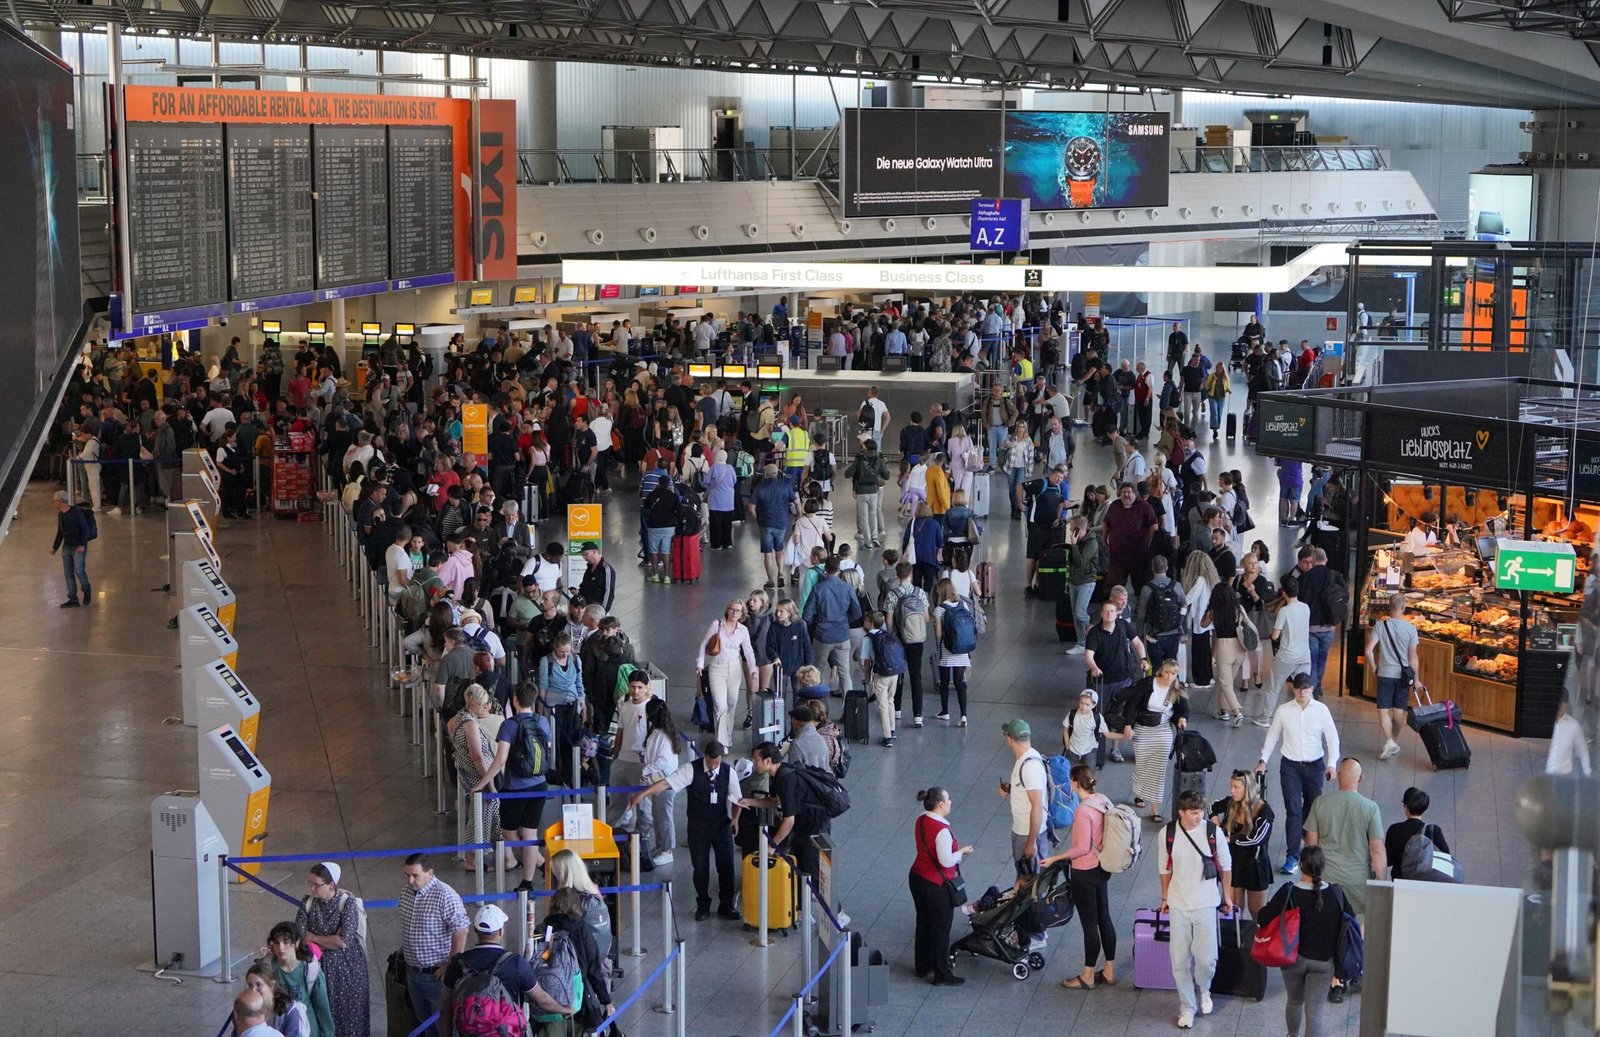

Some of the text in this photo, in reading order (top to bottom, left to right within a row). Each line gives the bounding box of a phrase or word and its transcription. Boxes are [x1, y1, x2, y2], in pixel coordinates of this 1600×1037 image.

[152, 92, 438, 121] FOR AN AFFORDABLE RENTAL CAR, THE DESTINATION IS SIXT.
[1128, 124, 1164, 136] SAMSUNG
[876, 156, 993, 171] Die neue Galaxy Watch Ultra
[976, 227, 1005, 247] A,Z
[700, 268, 985, 284] Lufthansa First Class Business Class
